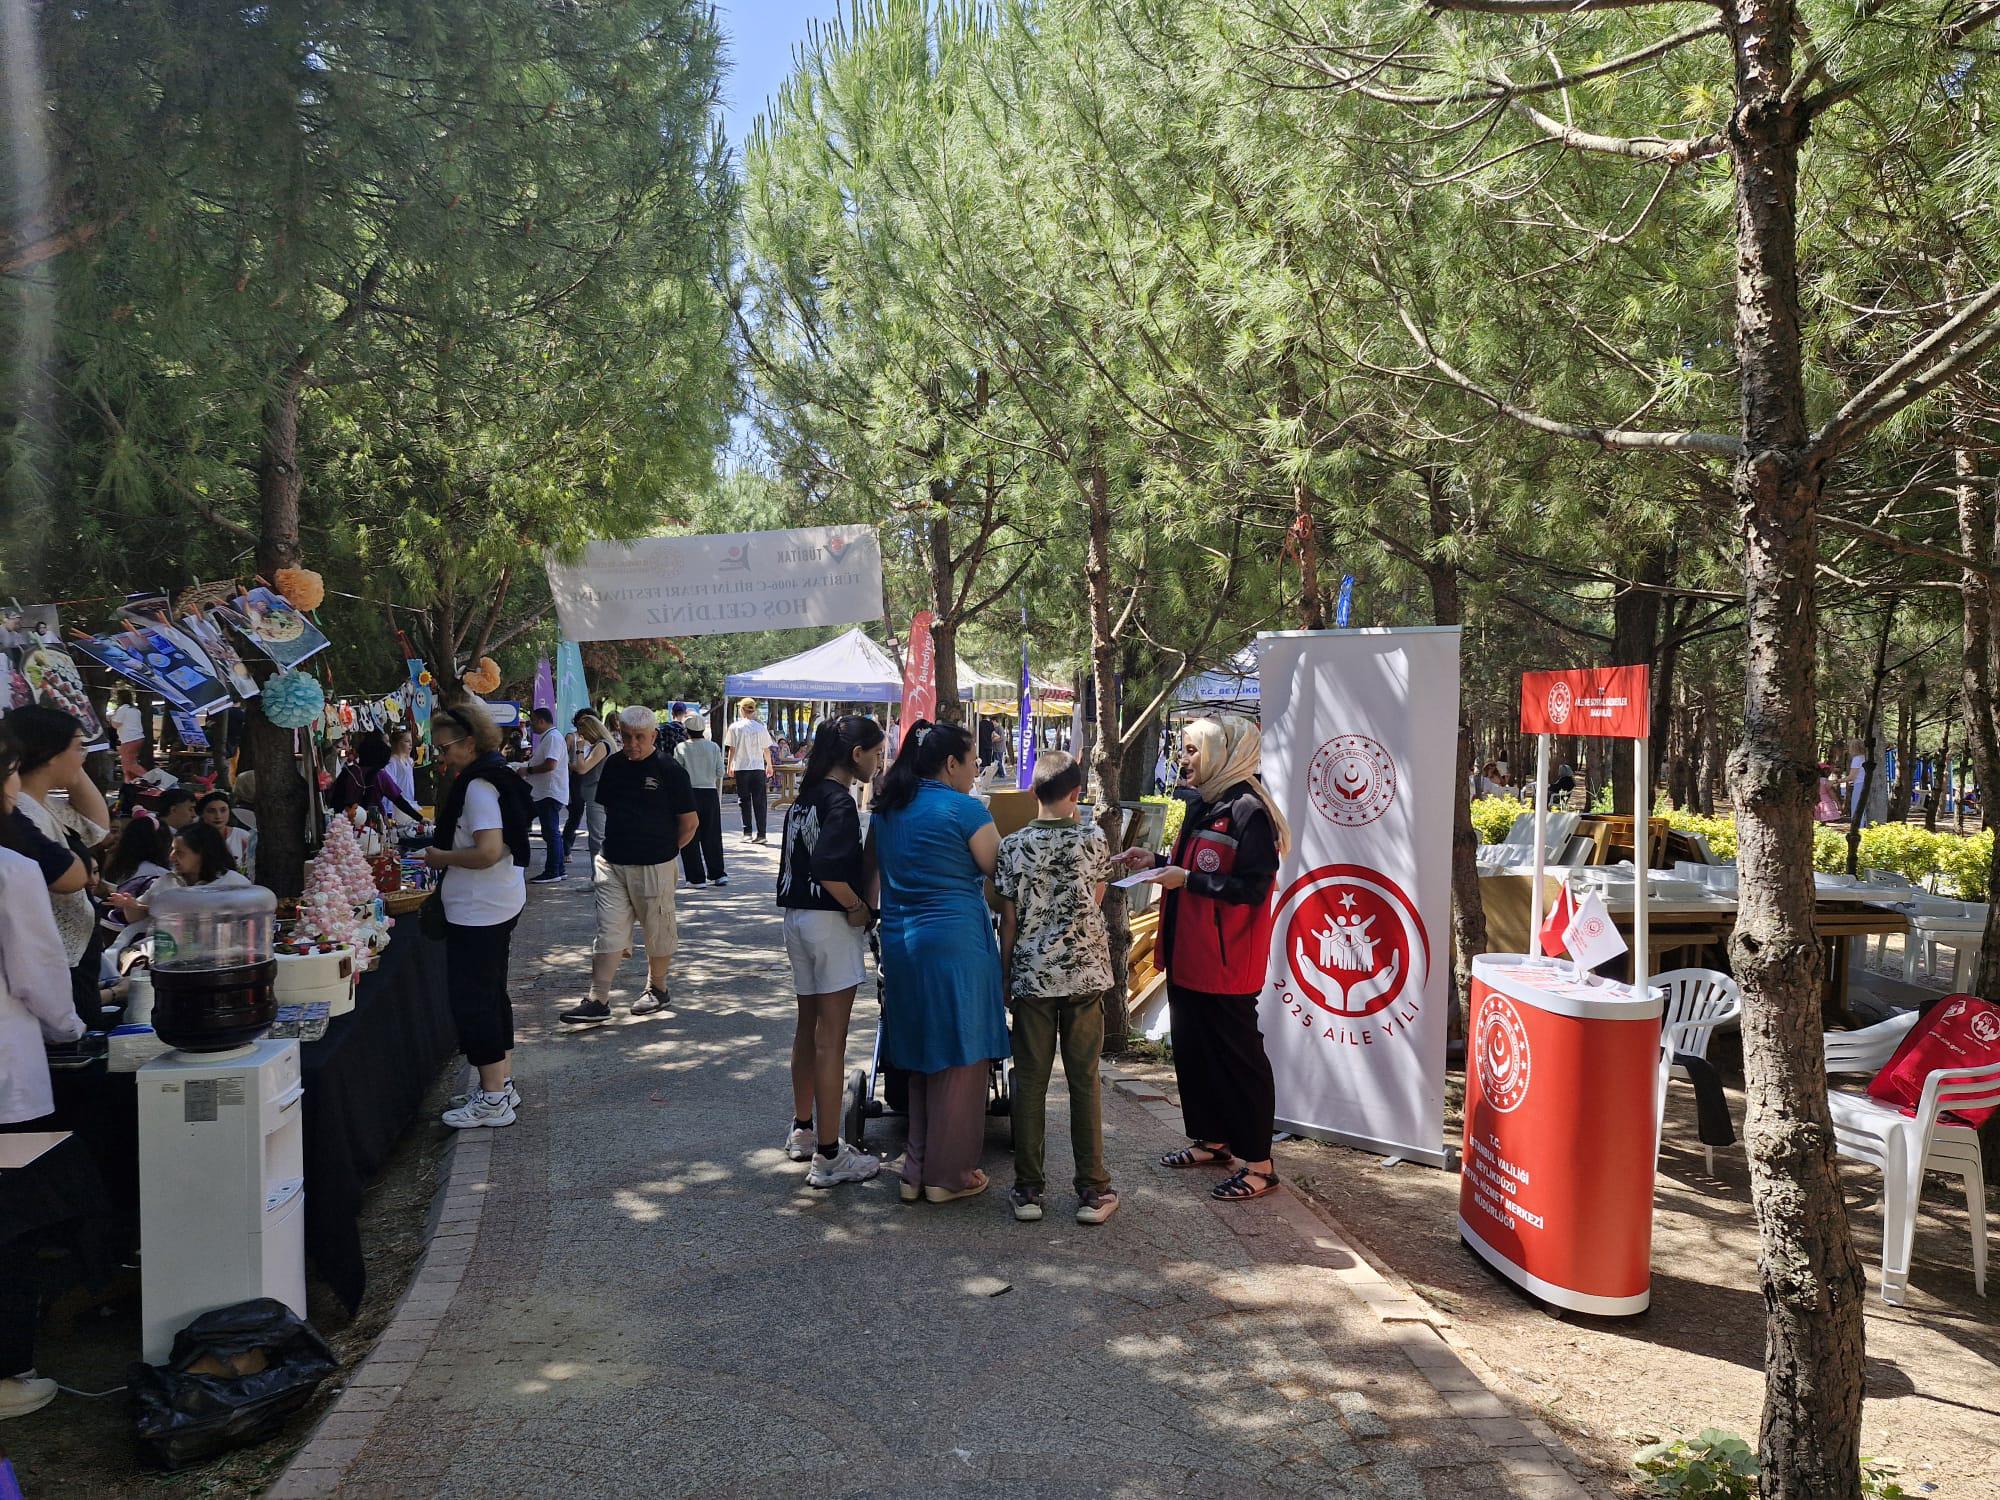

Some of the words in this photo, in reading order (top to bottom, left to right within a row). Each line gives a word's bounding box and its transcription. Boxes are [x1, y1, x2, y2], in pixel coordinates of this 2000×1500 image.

[1273, 979, 1313, 1027] 2025
[1323, 1027, 1373, 1045] AİLE
[1382, 1001, 1419, 1037] YILI
[1489, 1134, 1501, 1149] T.C.
[1505, 1198, 1544, 1230] MERKEZİ
